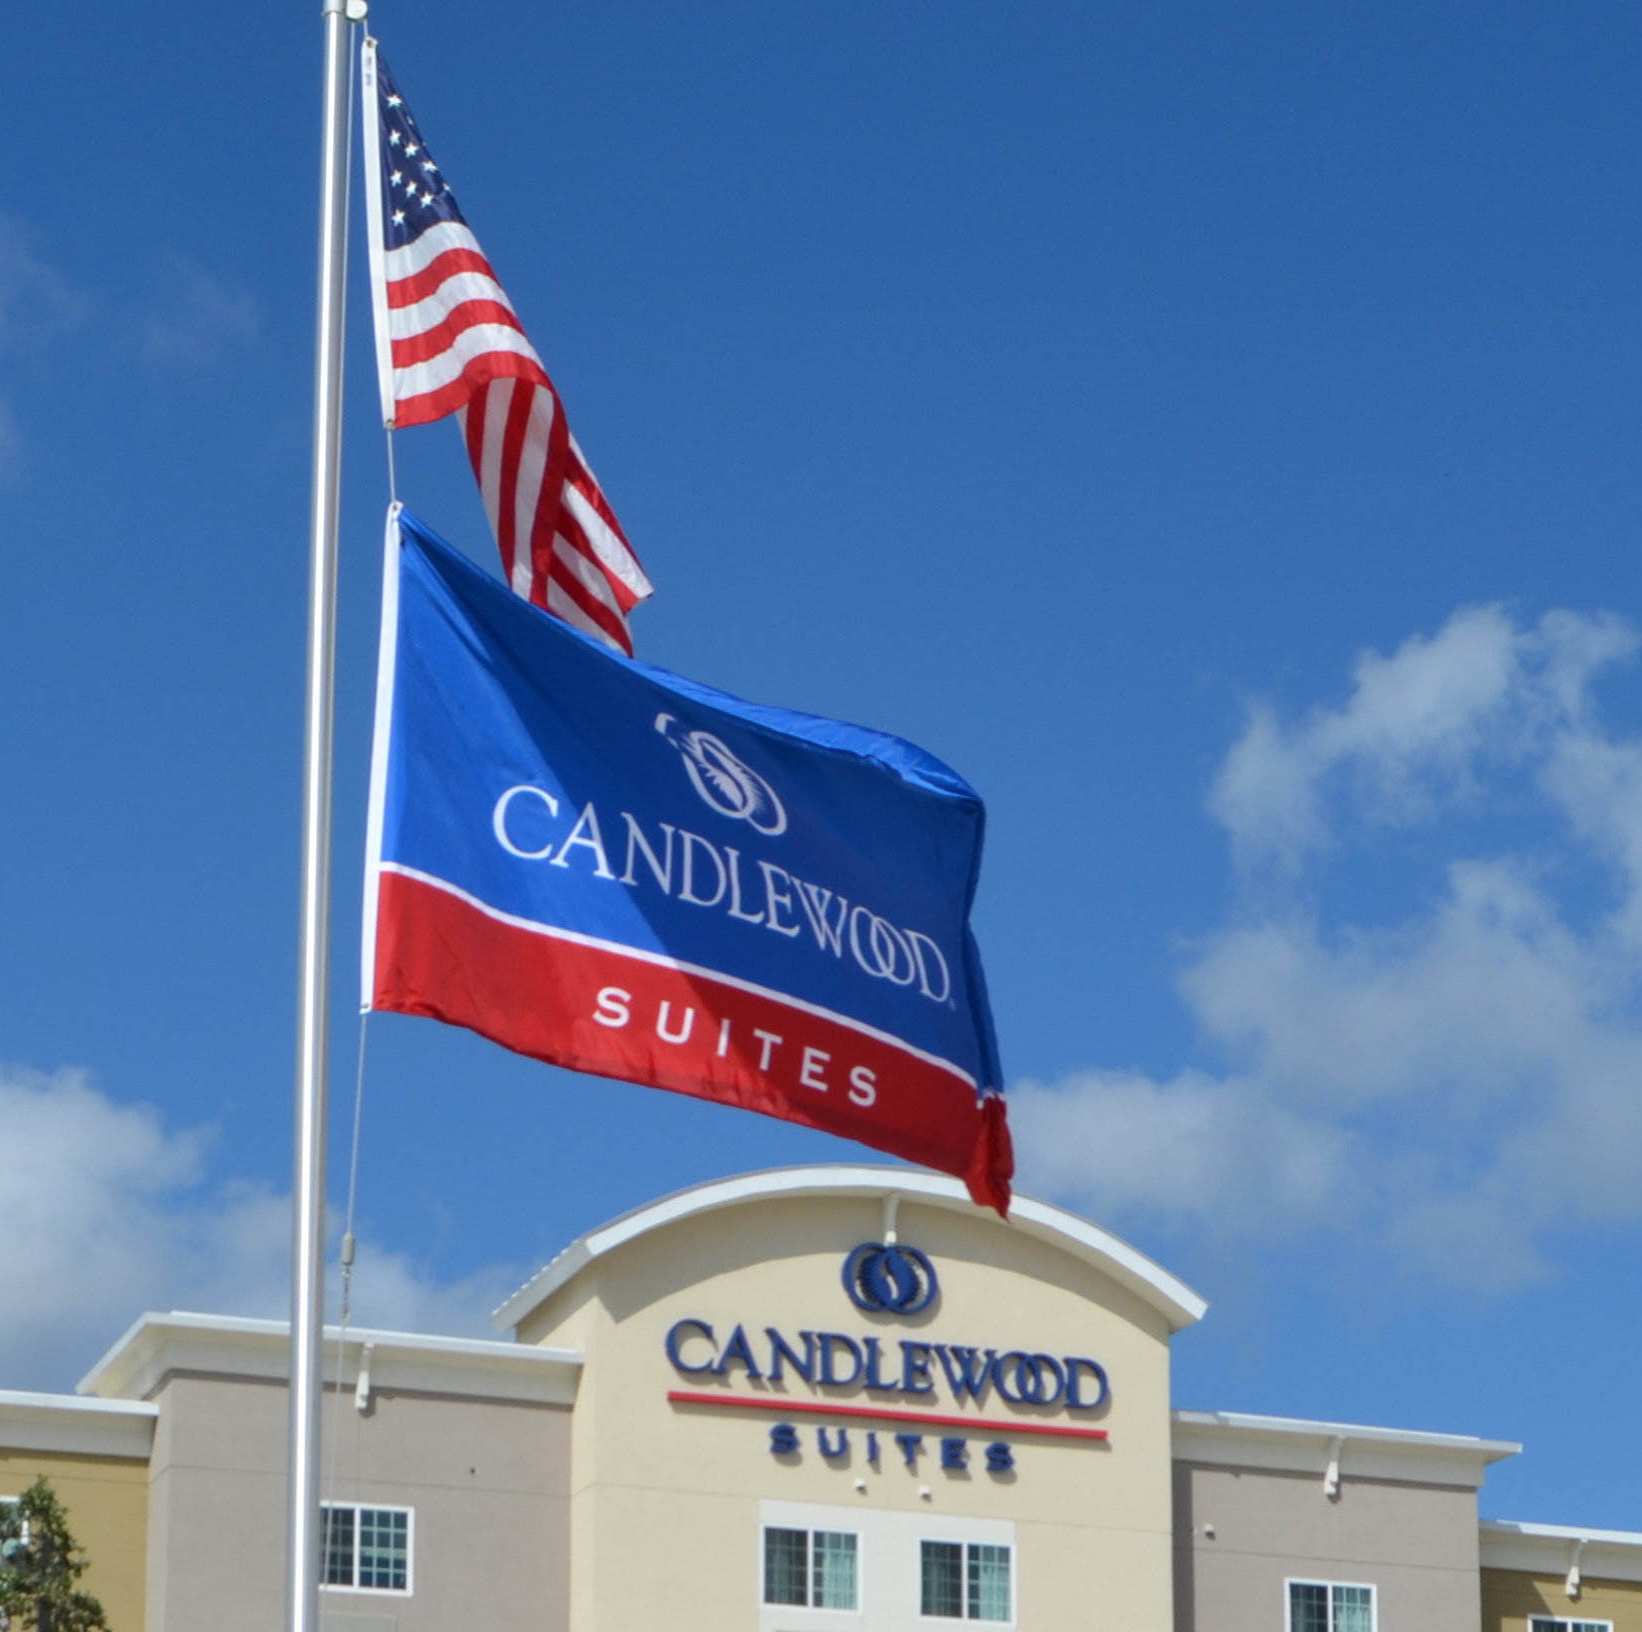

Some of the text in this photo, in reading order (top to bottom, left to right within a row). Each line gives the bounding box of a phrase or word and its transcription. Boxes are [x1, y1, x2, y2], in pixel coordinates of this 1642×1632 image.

[493, 785, 951, 1003] CANDLEWOOD
[593, 986, 879, 1108] SUITES
[665, 1318, 1110, 1409] CANDLEWOOD
[768, 1423, 1015, 1472] SUITES
